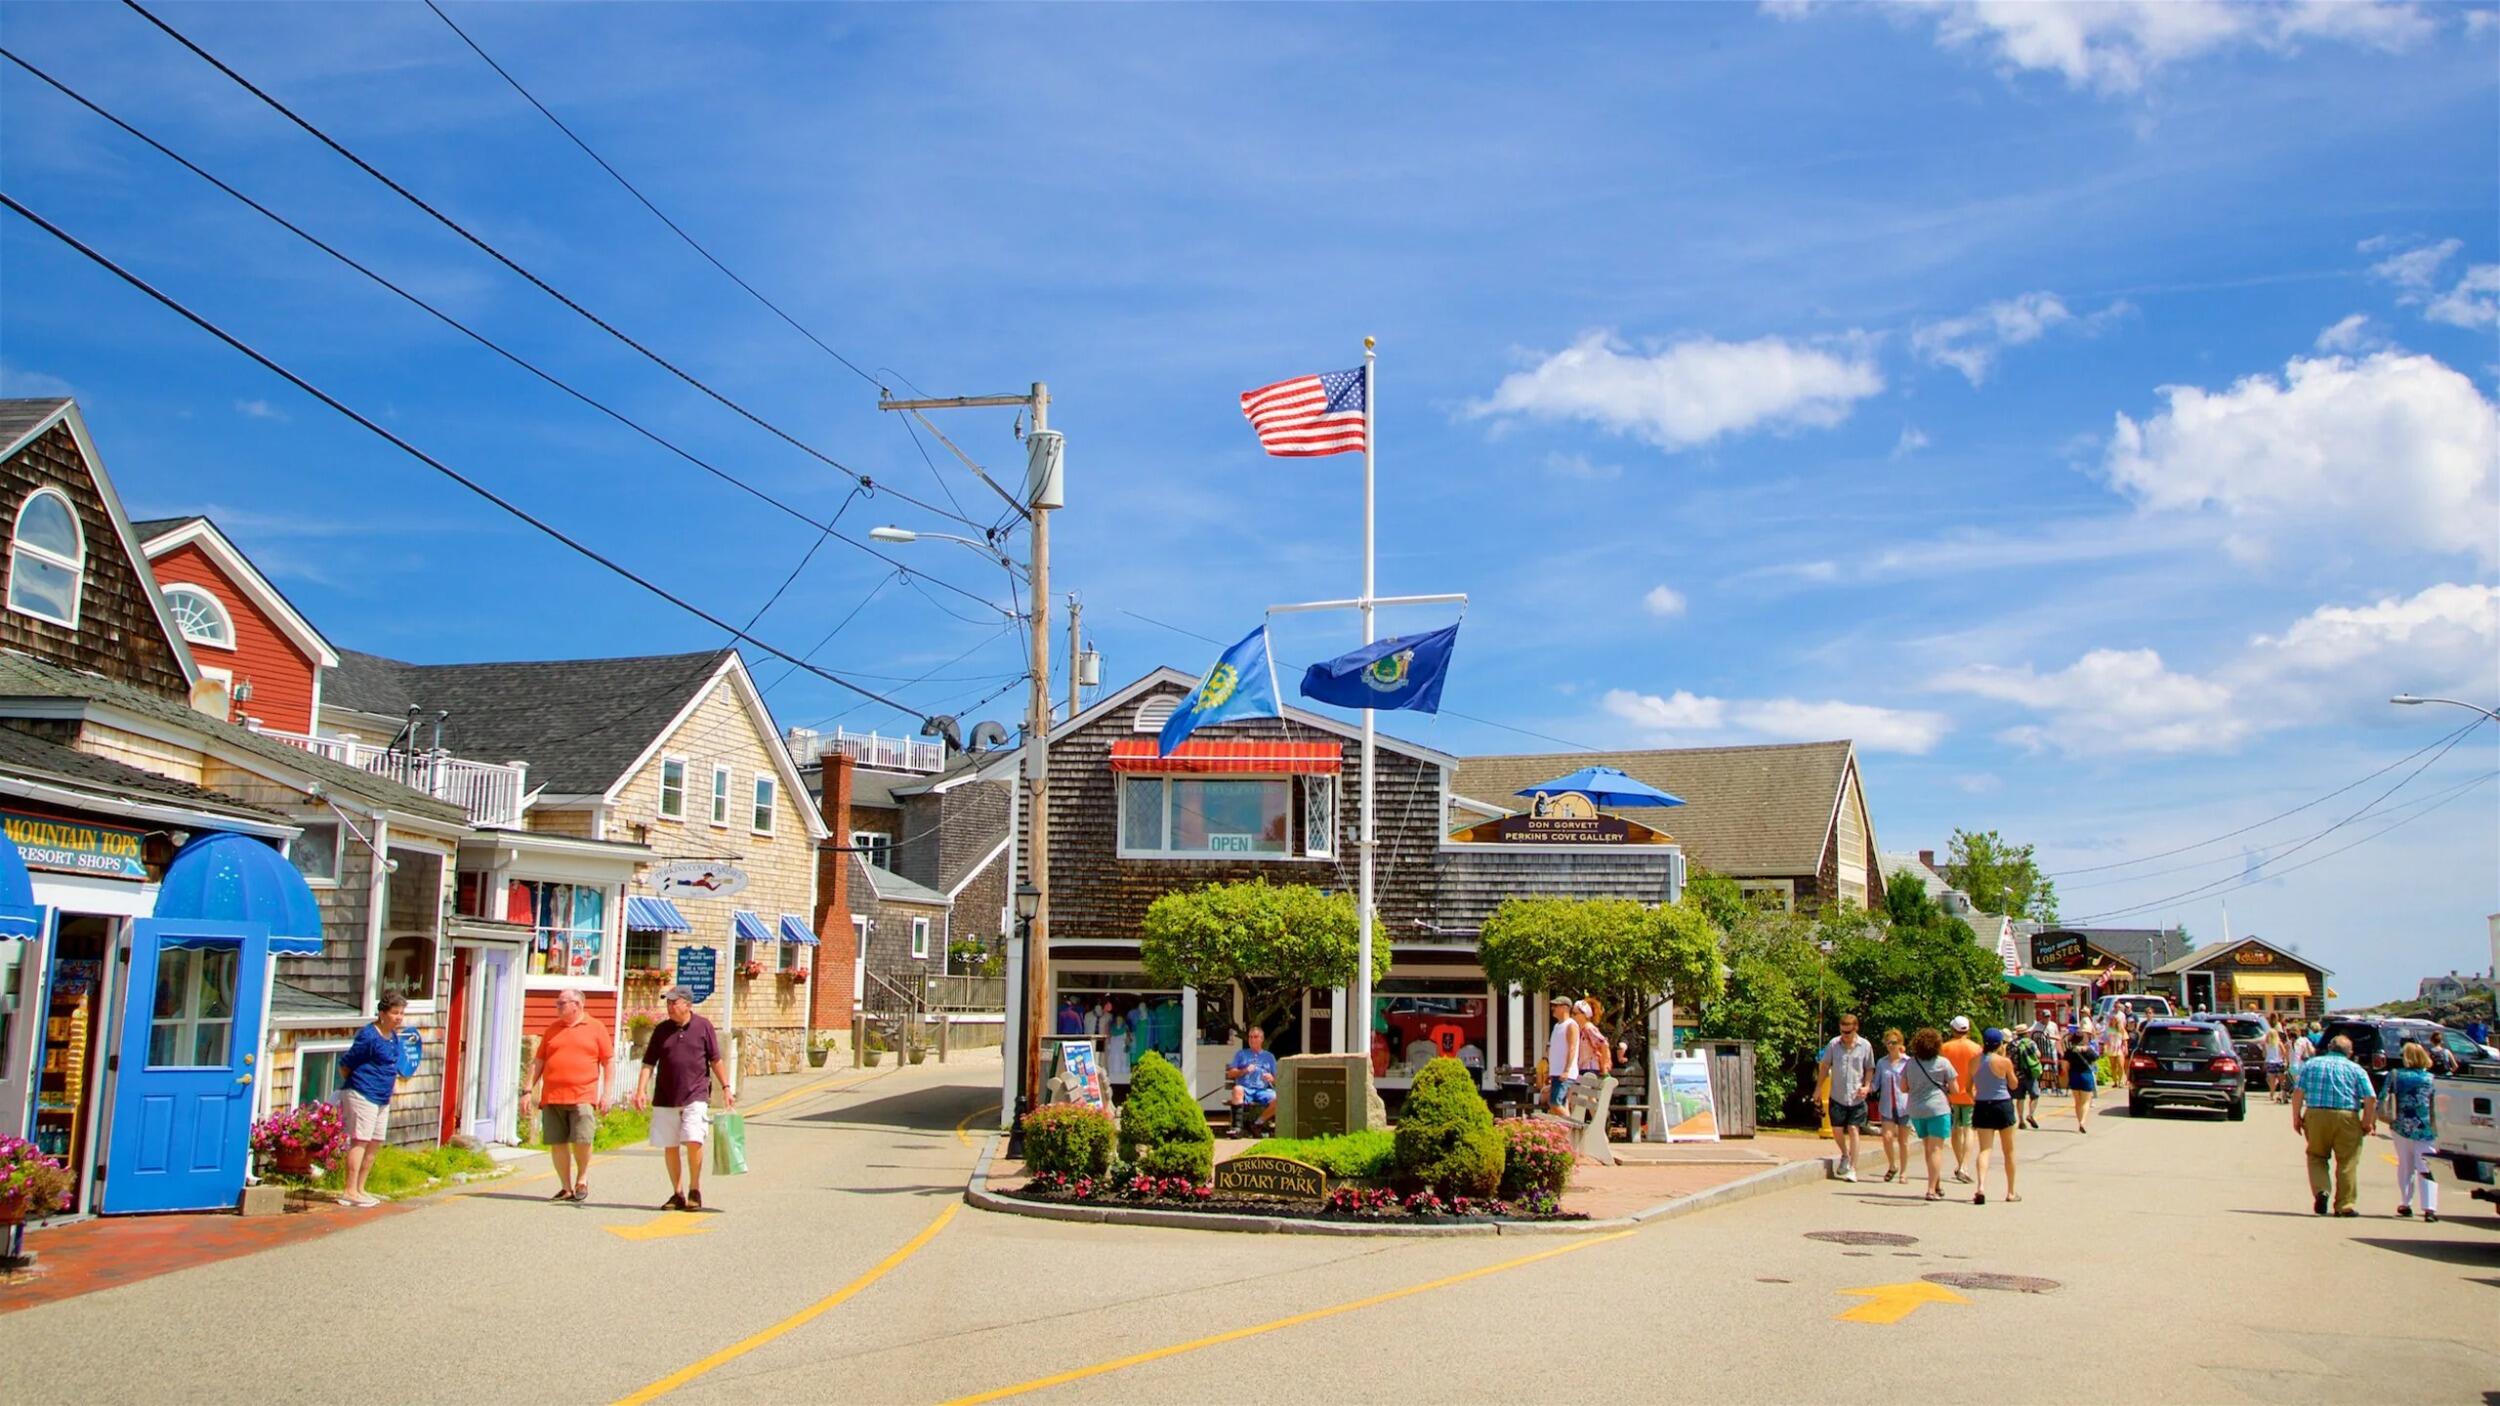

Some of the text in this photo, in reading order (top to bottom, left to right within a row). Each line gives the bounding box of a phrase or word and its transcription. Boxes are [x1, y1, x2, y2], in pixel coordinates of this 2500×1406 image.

[1528, 821, 1599, 829] DON GORVETT
[4, 818, 139, 857] MOUNTAIN TOPS
[1211, 836, 1249, 852] OPEN
[1505, 832, 1624, 841] PERKINS COVE GALLERY
[17, 846, 121, 871] RESORT SHOPS
[655, 865, 688, 880] PERKINS
[688, 864, 707, 873] COVE
[2036, 944, 2081, 965] LOBSTER
[1232, 1159, 1306, 1176] PERKINS COVE
[1220, 1171, 1317, 1195] ROTARY PARK
